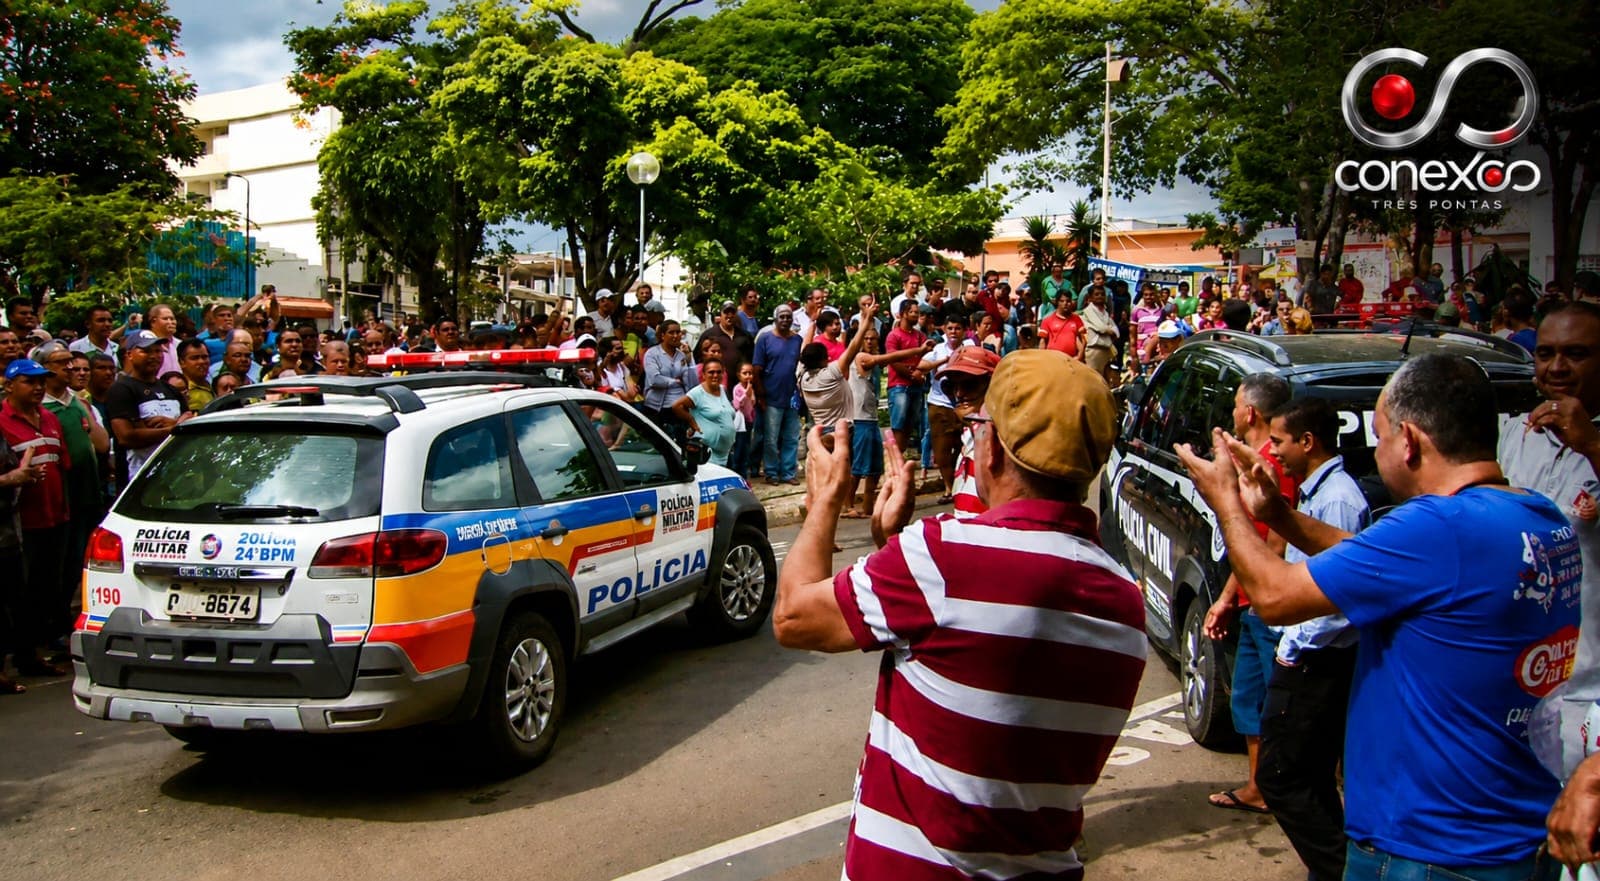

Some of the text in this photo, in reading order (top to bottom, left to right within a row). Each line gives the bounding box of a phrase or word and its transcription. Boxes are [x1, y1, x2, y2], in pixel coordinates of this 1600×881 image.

[662, 509, 694, 528] MILITAR
[136, 526, 190, 541] POLÍCIA
[132, 542, 188, 554] MILITAR
[1147, 522, 1173, 582] CIVIL
[587, 548, 707, 614] POLÍCIA
[95, 586, 120, 605] 190
